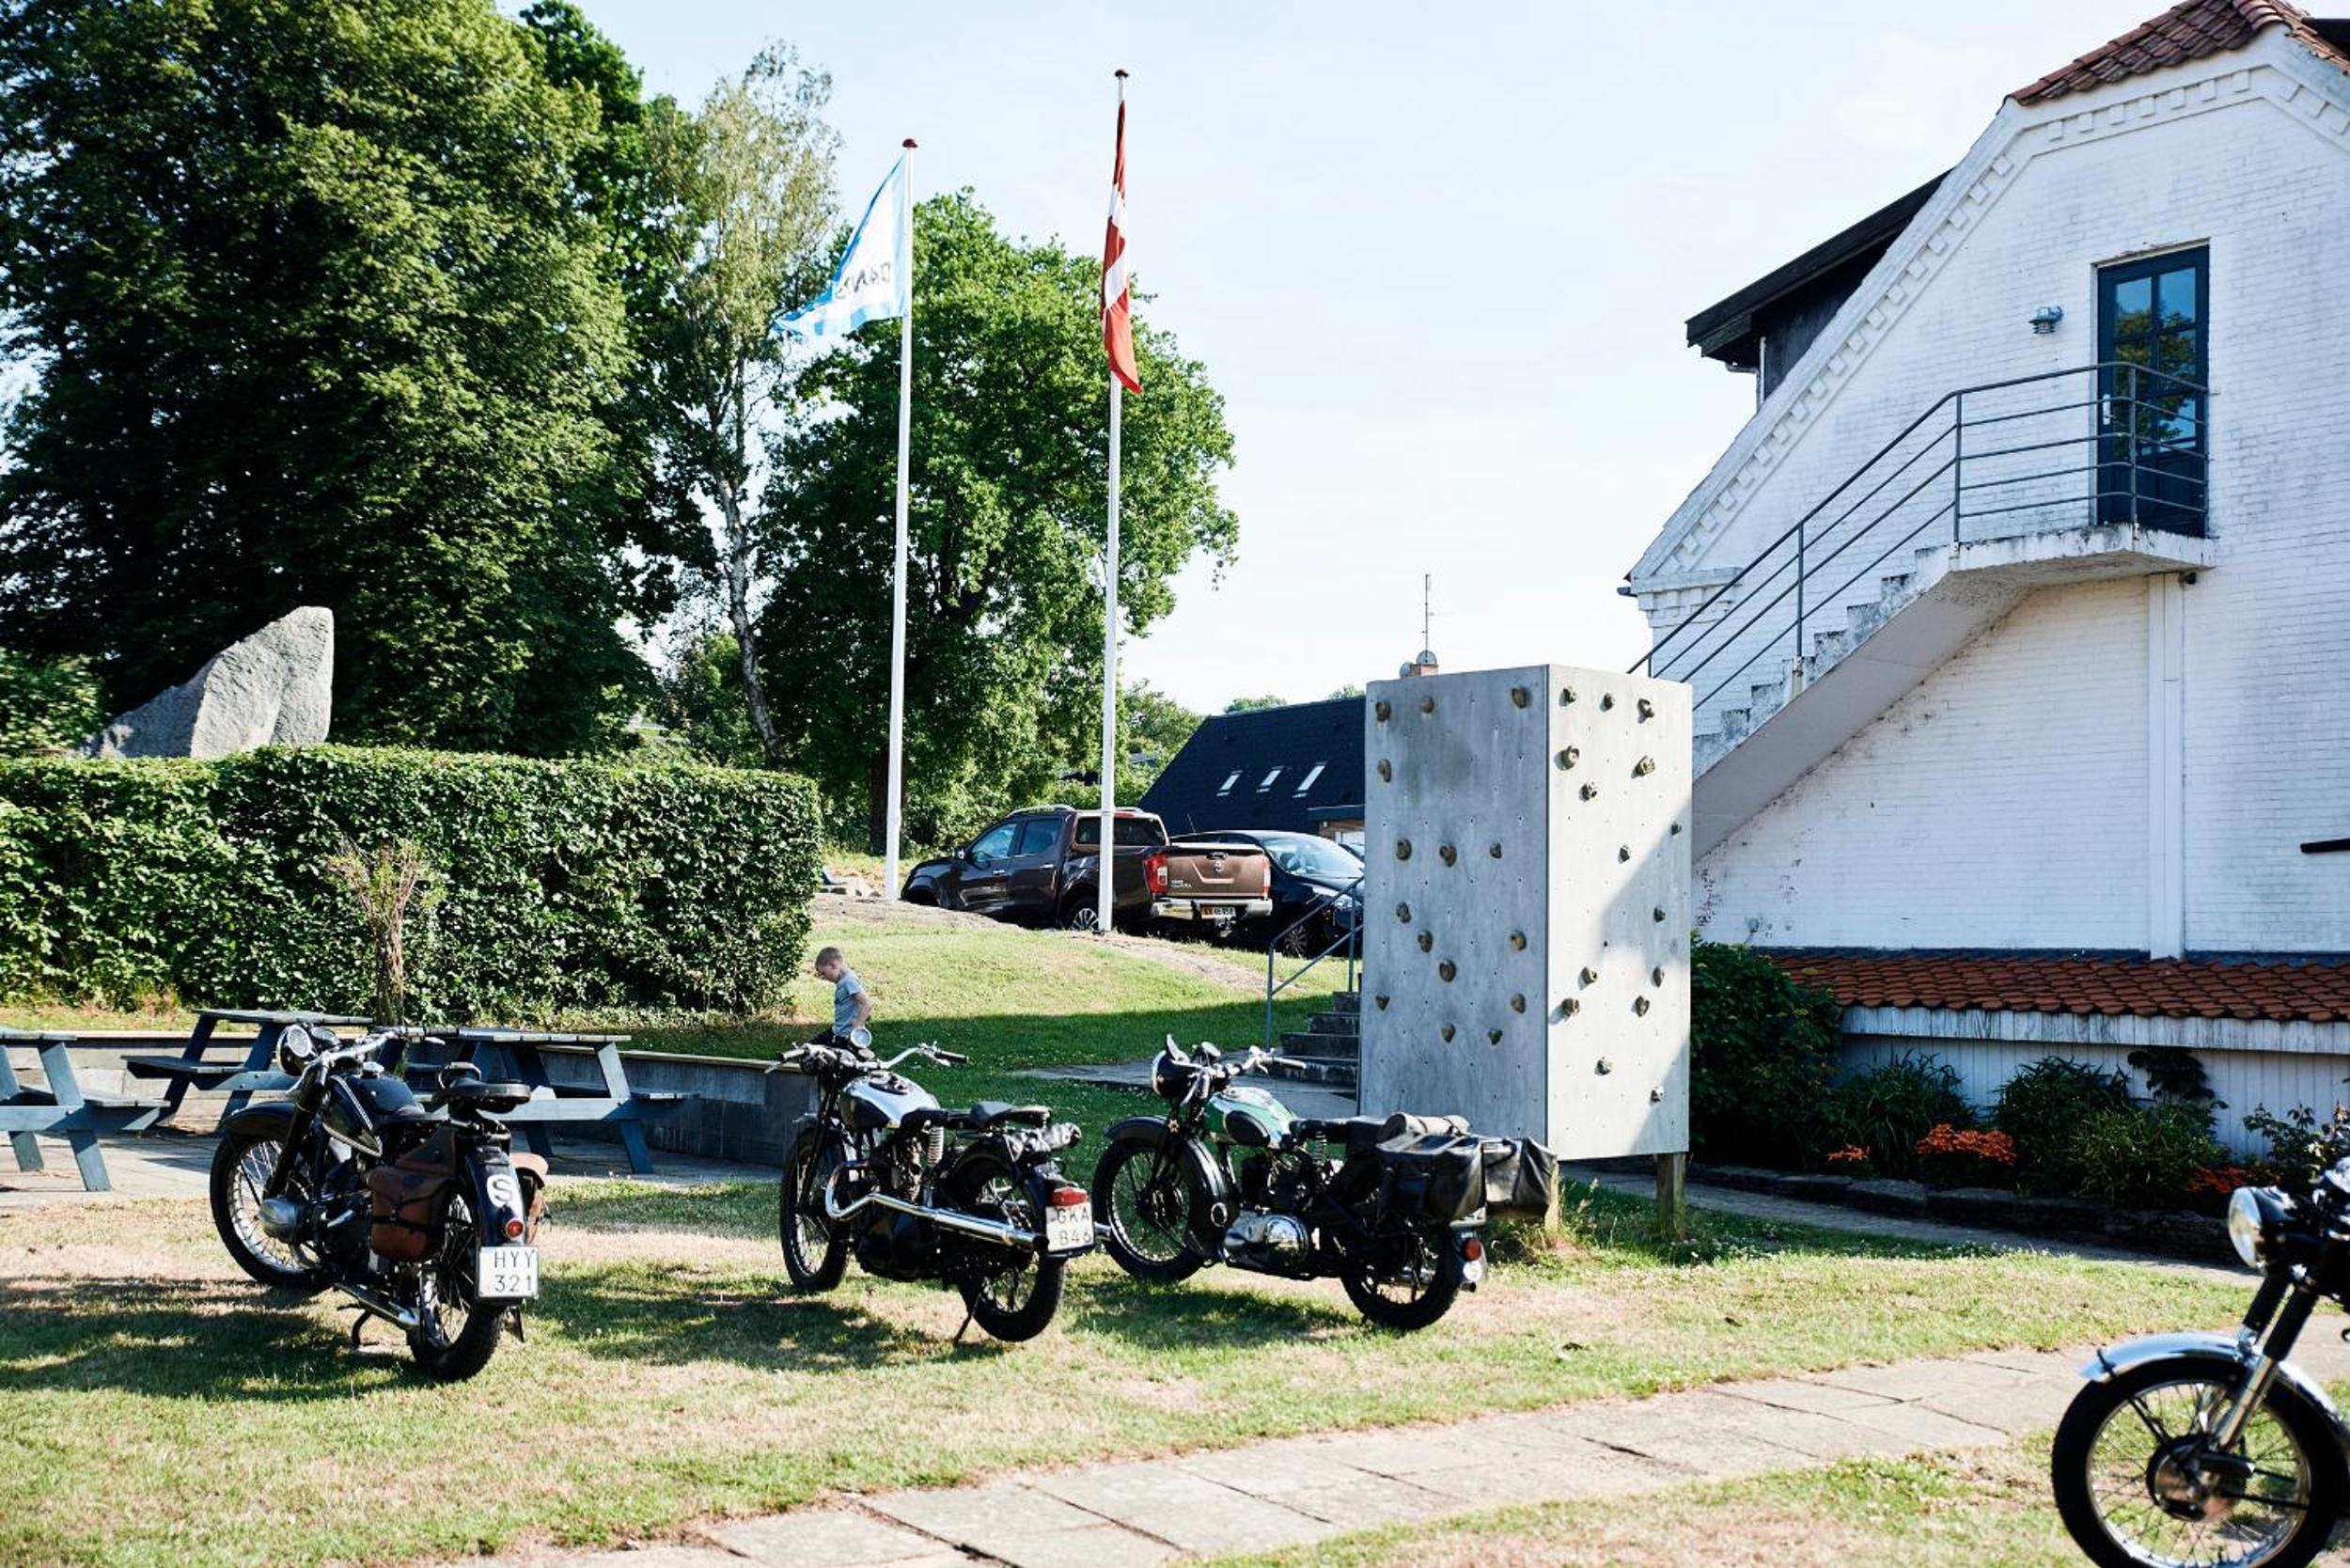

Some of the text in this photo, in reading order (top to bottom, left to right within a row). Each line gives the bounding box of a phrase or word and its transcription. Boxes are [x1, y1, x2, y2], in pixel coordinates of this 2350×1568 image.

[493, 1178, 513, 1202] S
[494, 1249, 536, 1269] HYY
[494, 1274, 532, 1293] 321
